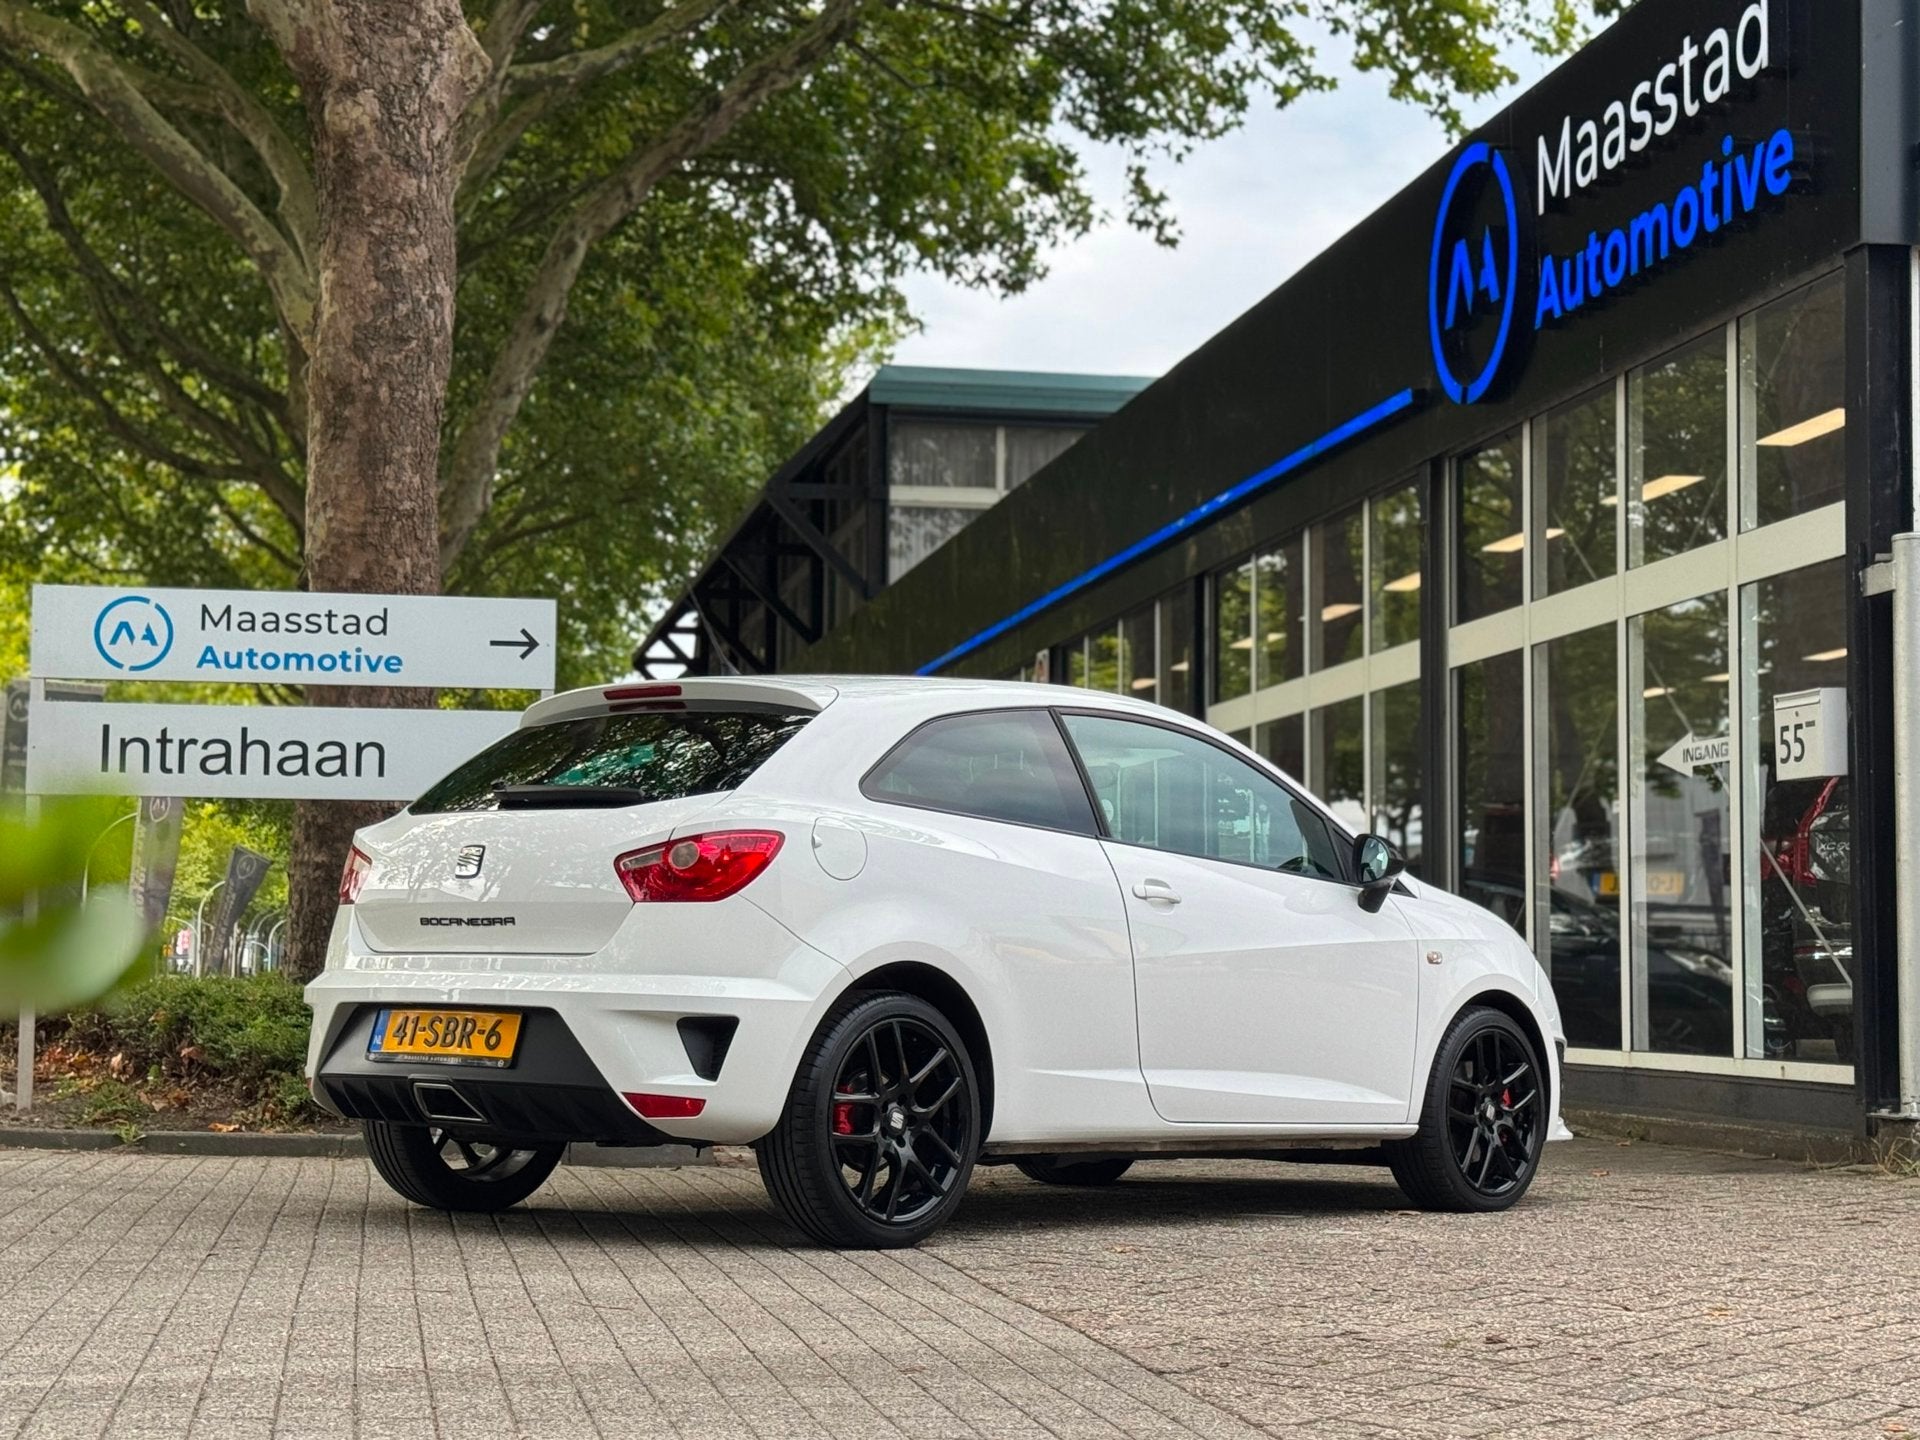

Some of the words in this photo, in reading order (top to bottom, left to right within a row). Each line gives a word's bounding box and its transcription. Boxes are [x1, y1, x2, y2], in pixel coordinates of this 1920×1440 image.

[1537, 0, 1769, 216] Maasstad
[1534, 129, 1794, 330] Automotive
[200, 603, 389, 637] Maasstad
[196, 645, 404, 673] Automotive
[101, 724, 386, 778] Intrahaan
[1682, 741, 1730, 763] INGANG
[420, 916, 516, 927] BOCANEGRA
[393, 1015, 503, 1051] 41-SBR-6
